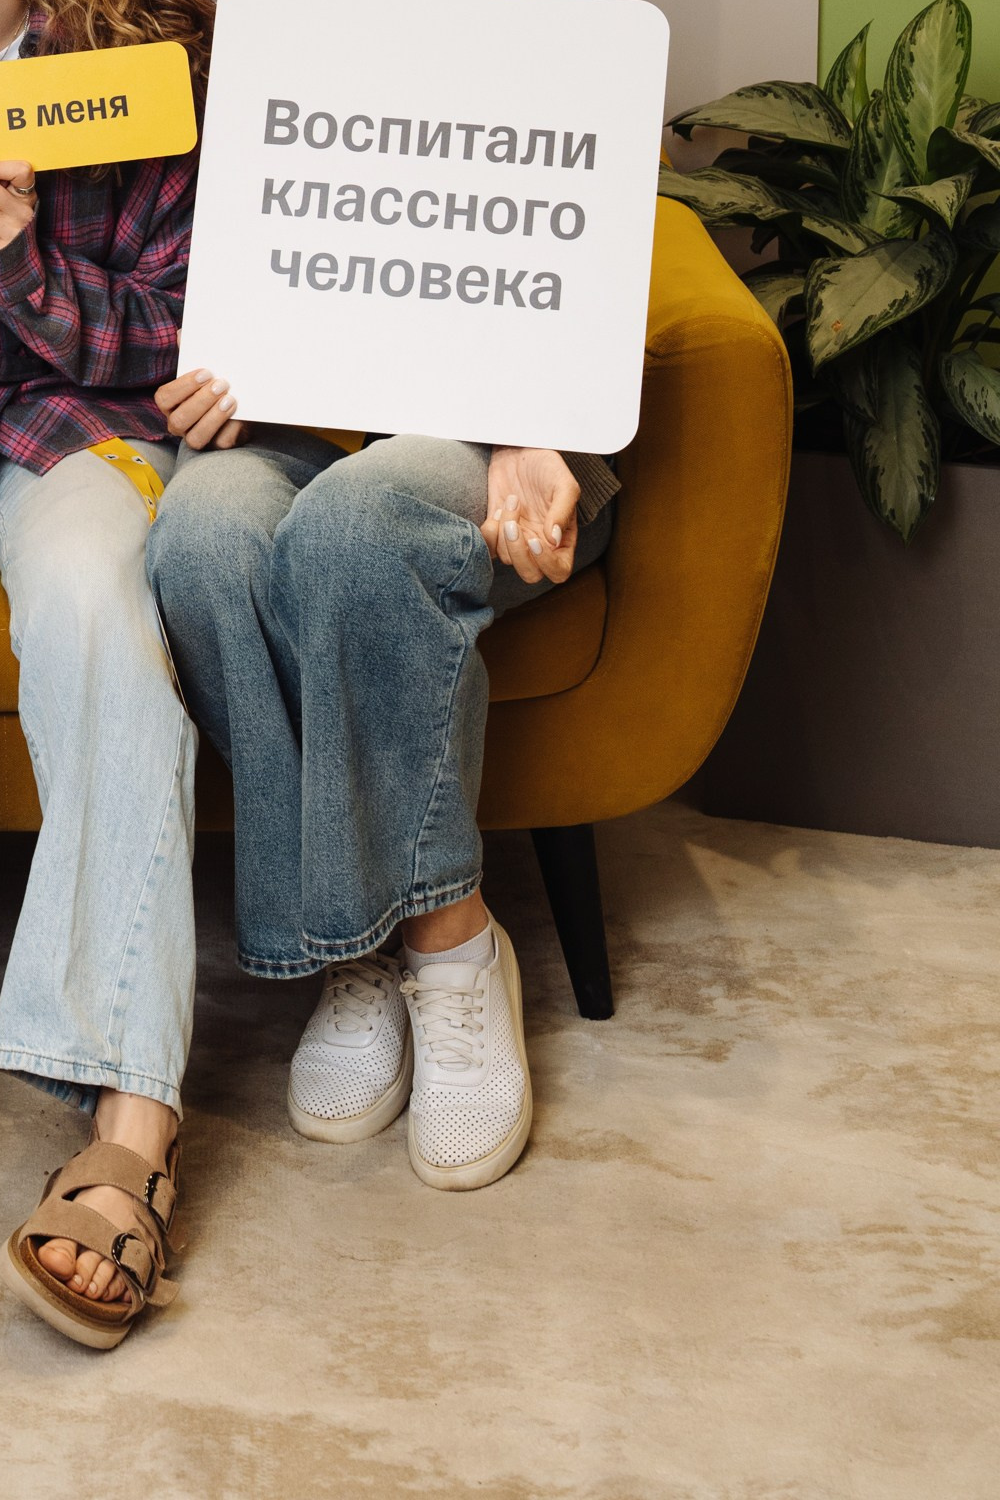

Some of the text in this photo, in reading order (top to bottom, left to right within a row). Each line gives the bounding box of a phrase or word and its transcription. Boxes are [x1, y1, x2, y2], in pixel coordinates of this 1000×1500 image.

[6, 107, 26, 130] в
[36, 95, 128, 126] меня
[263, 99, 597, 170] Воспитали
[260, 178, 586, 240] классного
[269, 249, 563, 311] человека
